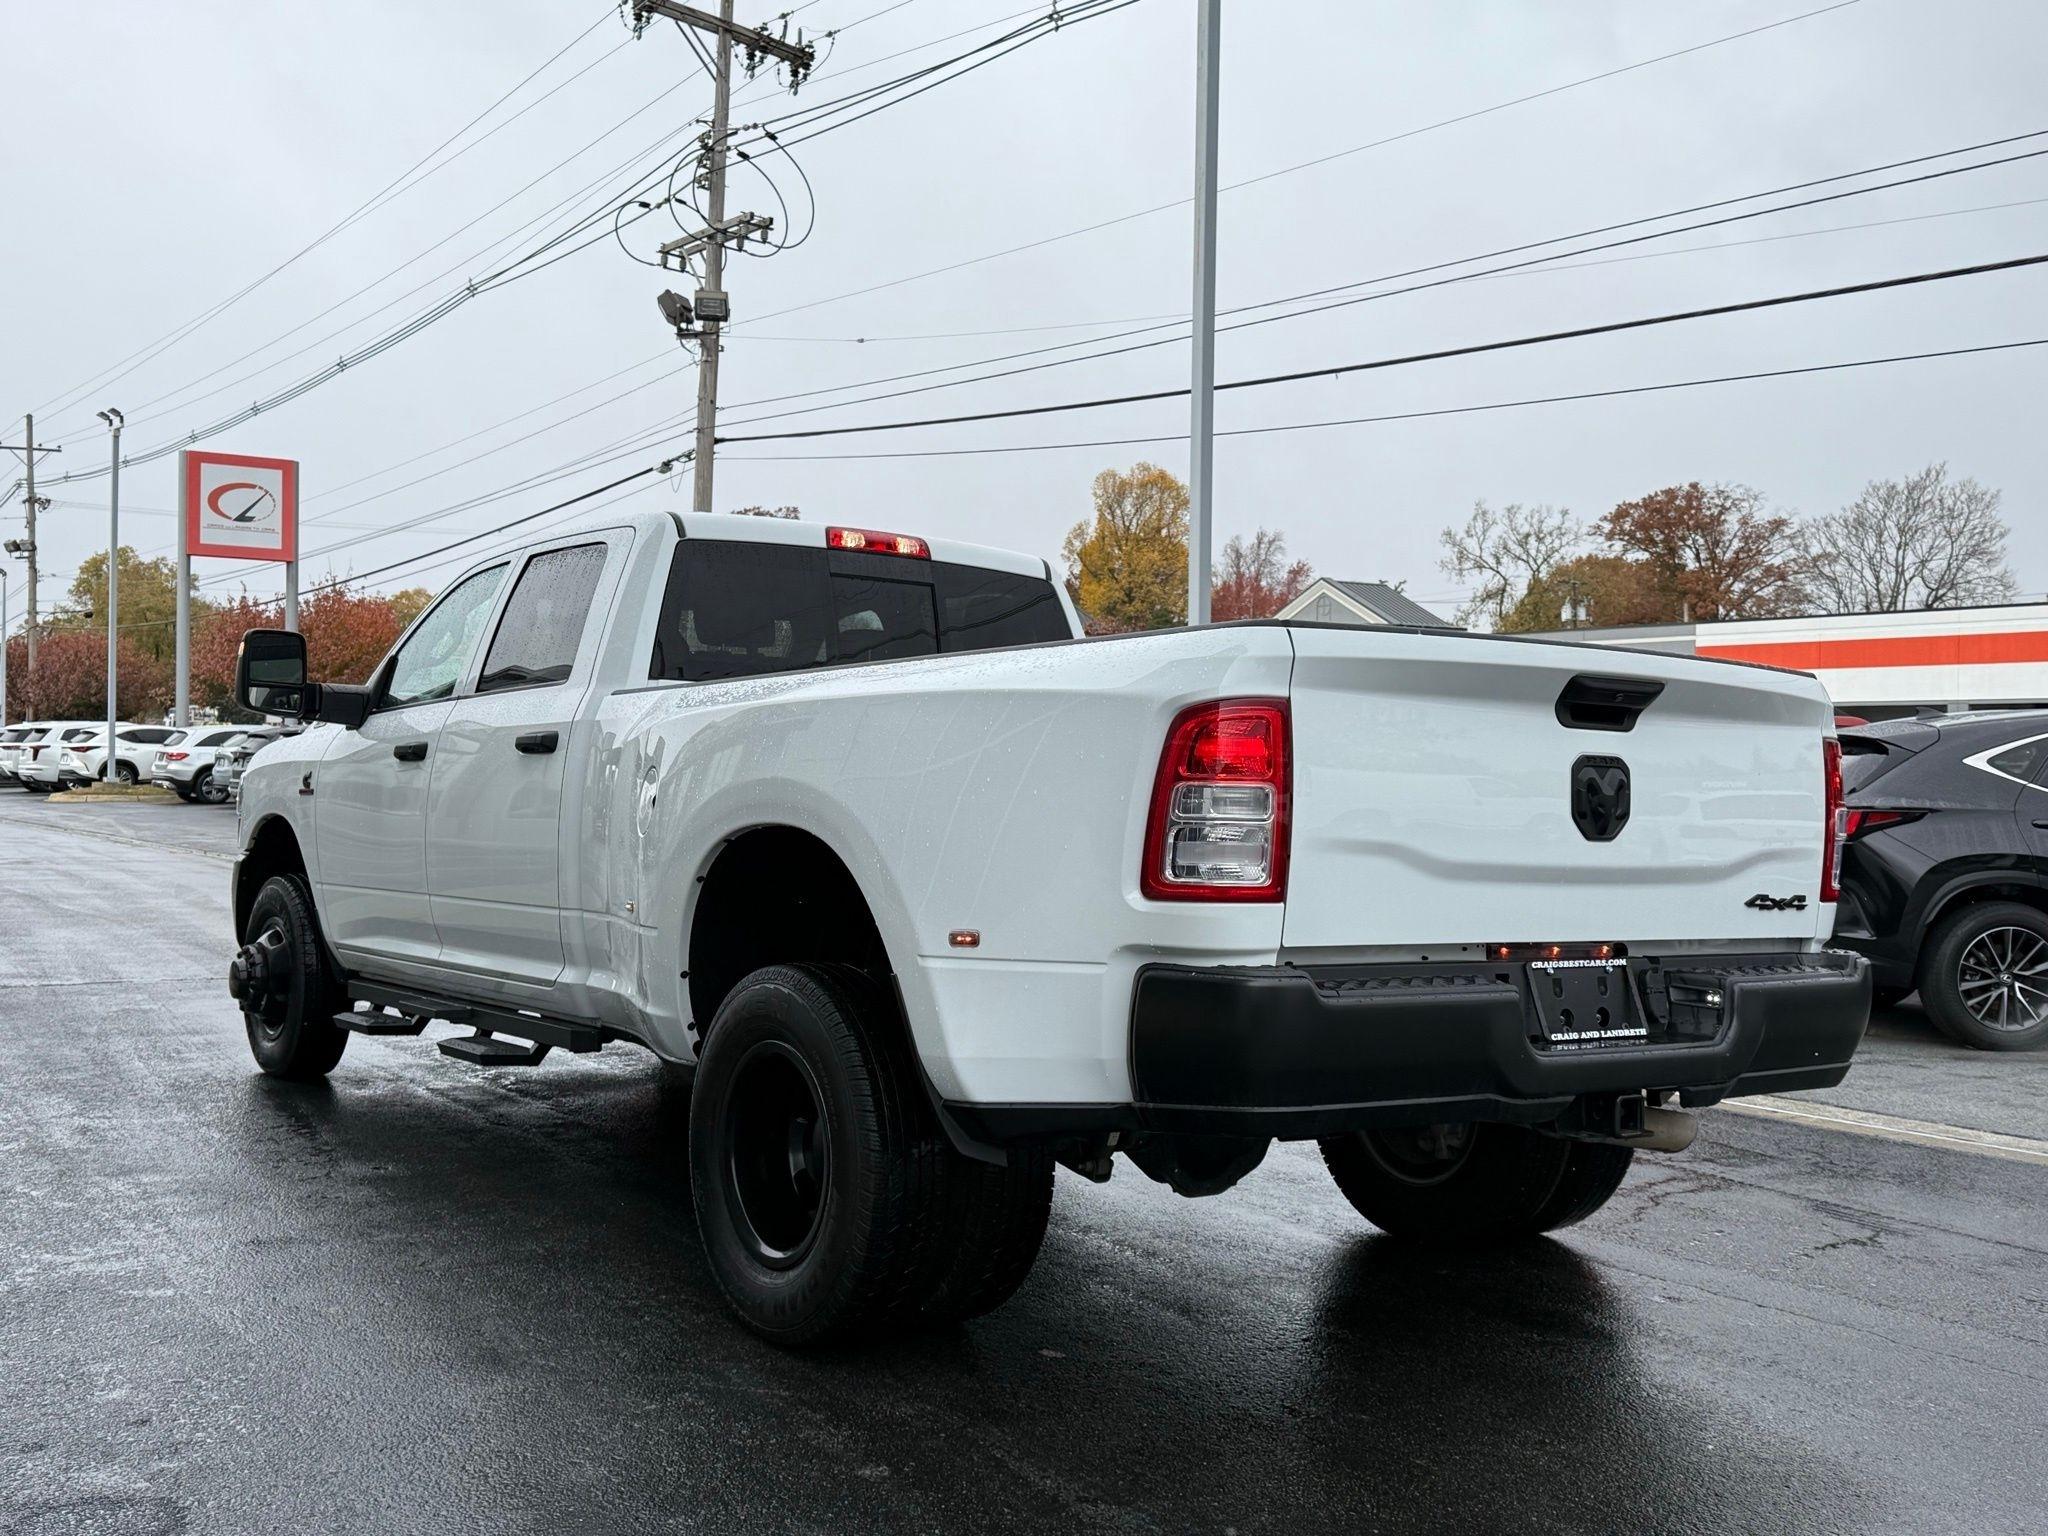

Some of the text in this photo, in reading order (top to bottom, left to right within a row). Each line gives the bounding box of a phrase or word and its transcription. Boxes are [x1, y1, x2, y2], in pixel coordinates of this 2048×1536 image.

[1744, 894, 1808, 910] 4x4
[1531, 959, 1627, 969] CRAIGSBESTCARS.COM
[1551, 1028, 1647, 1041] CRAIG AND LANDRETH
